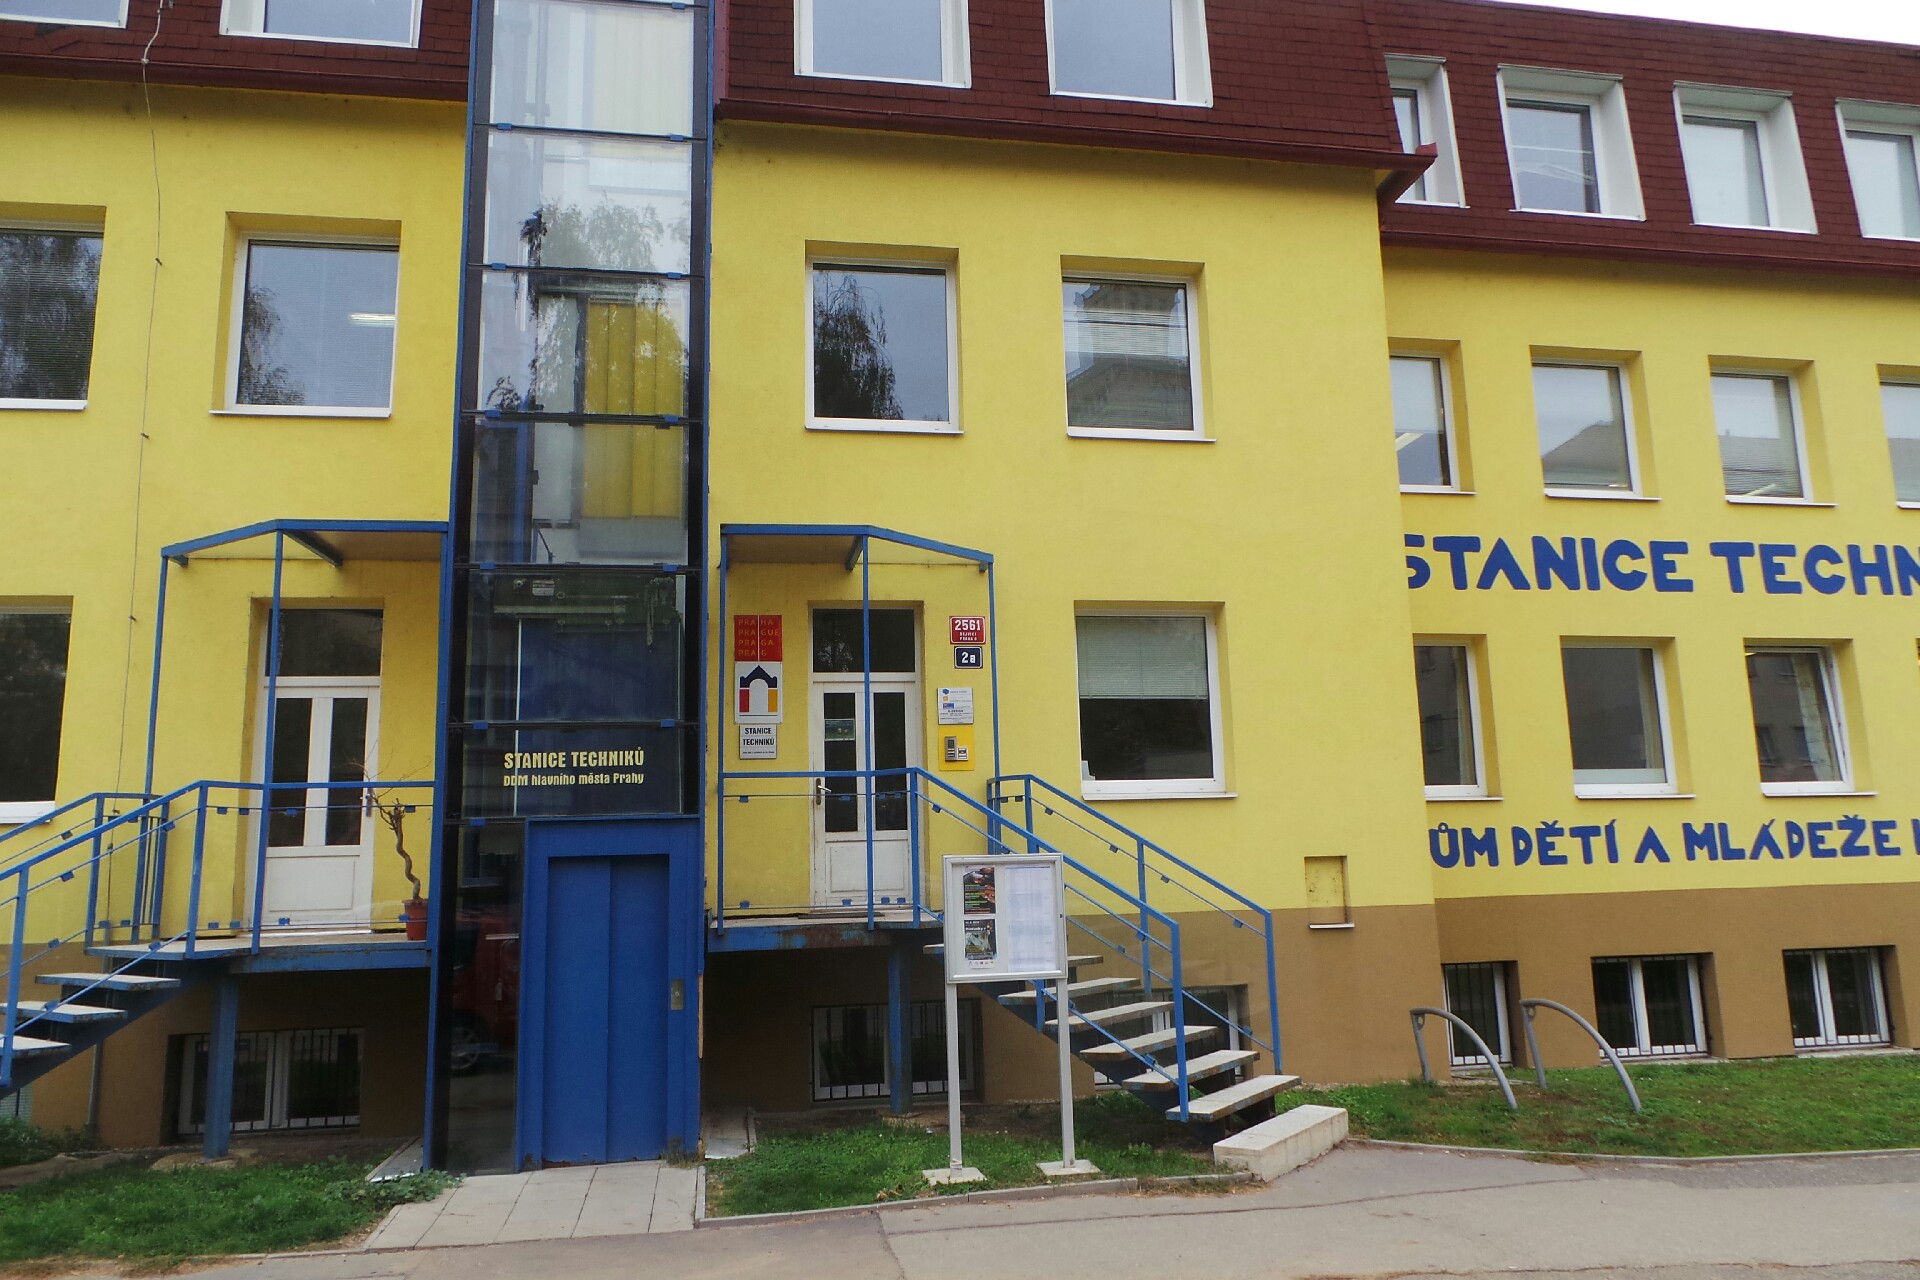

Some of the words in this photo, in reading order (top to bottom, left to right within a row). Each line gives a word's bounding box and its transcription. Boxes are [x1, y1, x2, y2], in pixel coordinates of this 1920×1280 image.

[1404, 533, 1694, 592] STANICE
[954, 619, 981, 631] 2561
[961, 651, 976, 664] 2a
[744, 727, 773, 735] STANICE
[742, 736, 775, 746] TECHNIKŮ
[503, 752, 567, 769] STANICE
[571, 746, 645, 768] TECHNIKŮ
[503, 775, 529, 787] DDM
[531, 773, 576, 786] hlavního
[578, 772, 611, 785] města
[612, 772, 645, 785] Prahy
[1510, 818, 1619, 866] DĚTÍ
[1633, 825, 1671, 864] A
[1682, 814, 1902, 861] MLÁDEŽE
